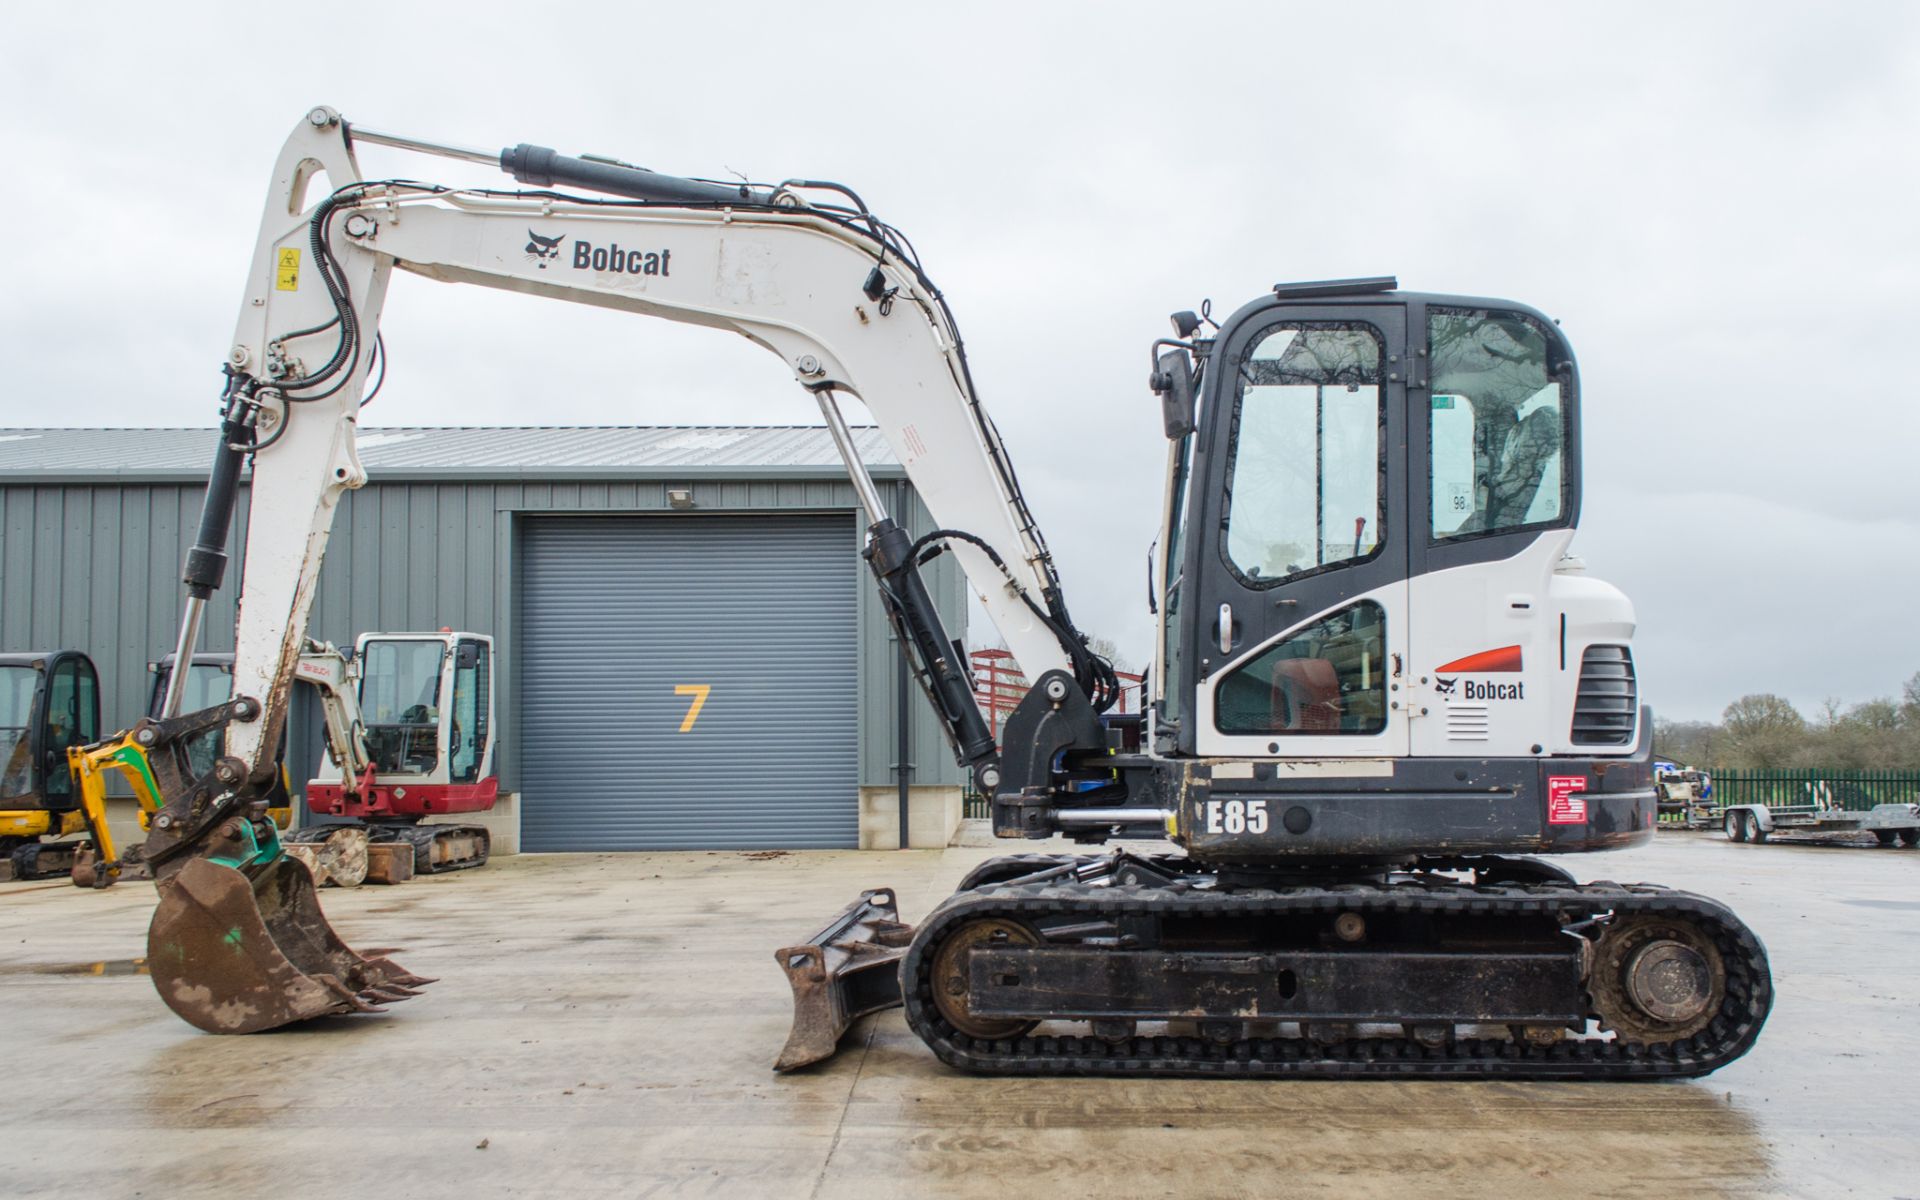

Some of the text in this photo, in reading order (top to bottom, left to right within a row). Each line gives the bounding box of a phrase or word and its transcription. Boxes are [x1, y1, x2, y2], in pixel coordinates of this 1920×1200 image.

[573, 240, 671, 277] Bobcat
[1465, 680, 1524, 700] Bobcat
[673, 684, 711, 732] 7
[1207, 800, 1269, 834] E85
